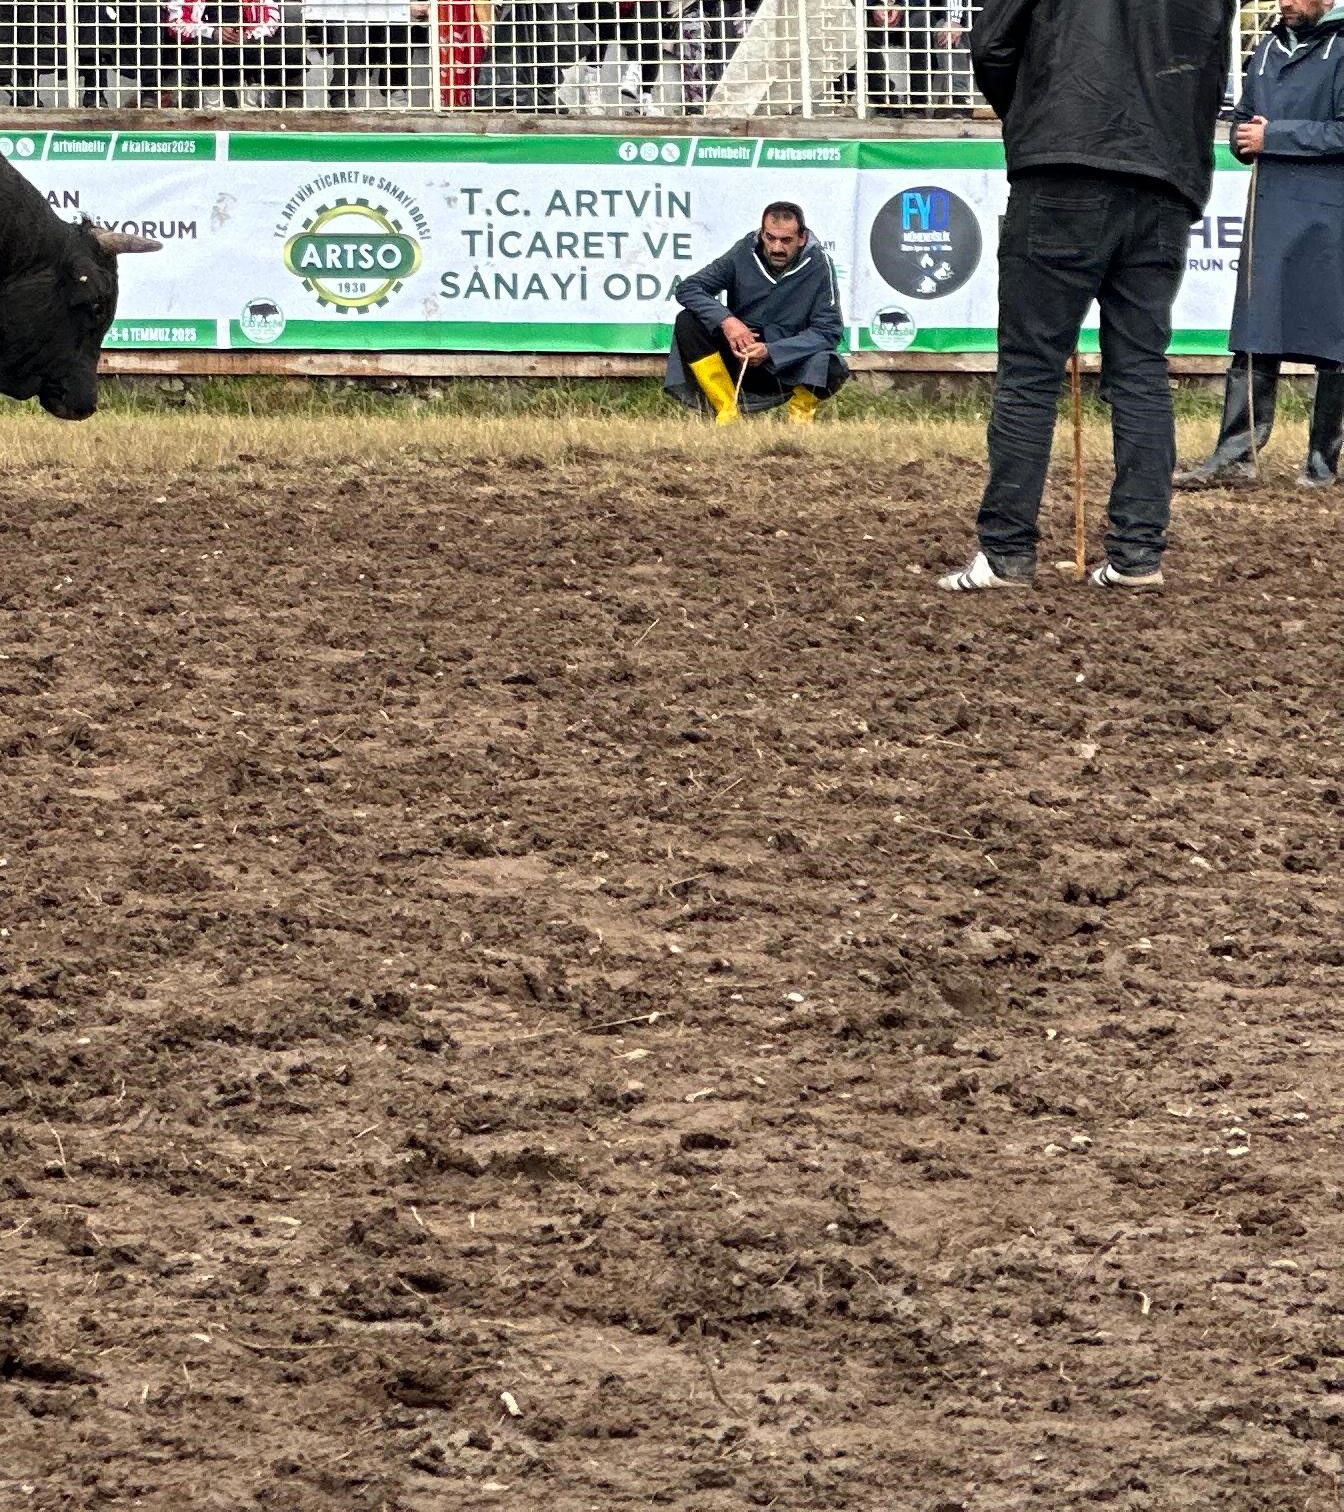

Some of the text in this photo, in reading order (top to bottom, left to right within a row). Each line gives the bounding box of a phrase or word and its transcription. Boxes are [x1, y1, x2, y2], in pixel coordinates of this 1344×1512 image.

[281, 182, 314, 221] ARTVİN
[314, 170, 360, 192] TİCARET
[376, 177, 418, 208] SANAYİ
[409, 205, 433, 241] ODASI
[461, 183, 692, 219] T.C. ARTVİN
[300, 243, 403, 270] ARTSO
[461, 223, 694, 260] TİCARET VE
[440, 265, 589, 301] SANAYİ
[130, 327, 172, 342] TEMMUZ
[172, 327, 197, 342] 2025
